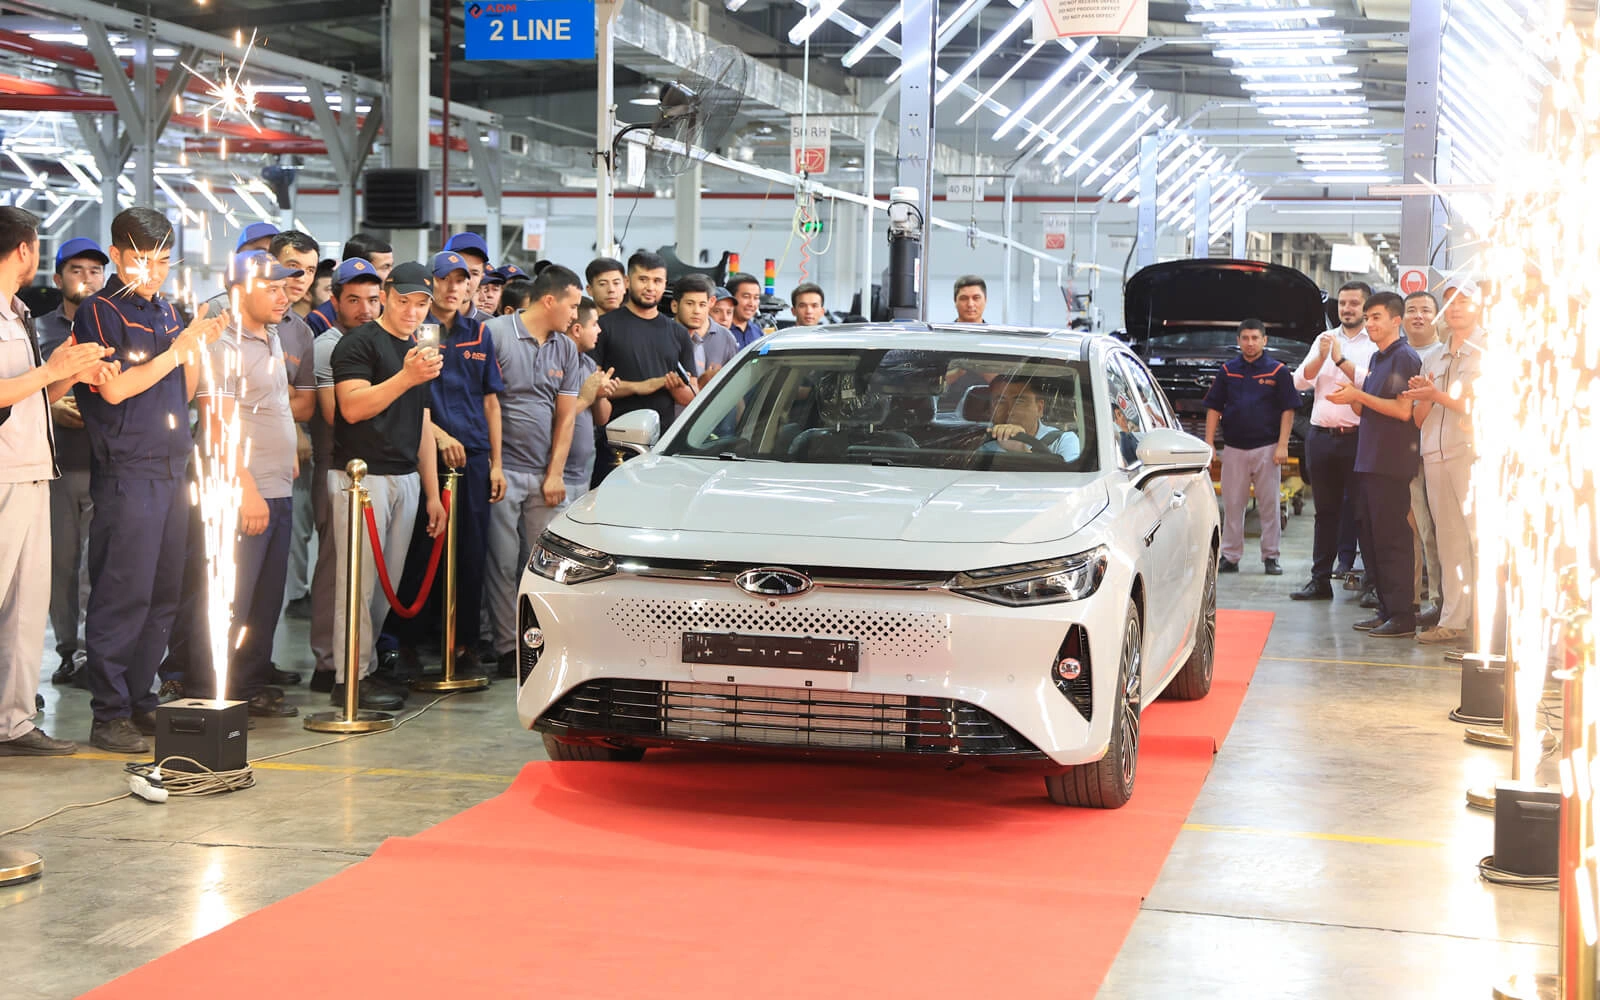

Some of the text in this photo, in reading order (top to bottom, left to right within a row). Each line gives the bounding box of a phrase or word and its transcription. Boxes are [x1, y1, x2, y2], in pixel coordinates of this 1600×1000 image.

[485, 4, 517, 13] ADM
[489, 19, 571, 41] 2 LINE
[811, 127, 827, 137] RH
